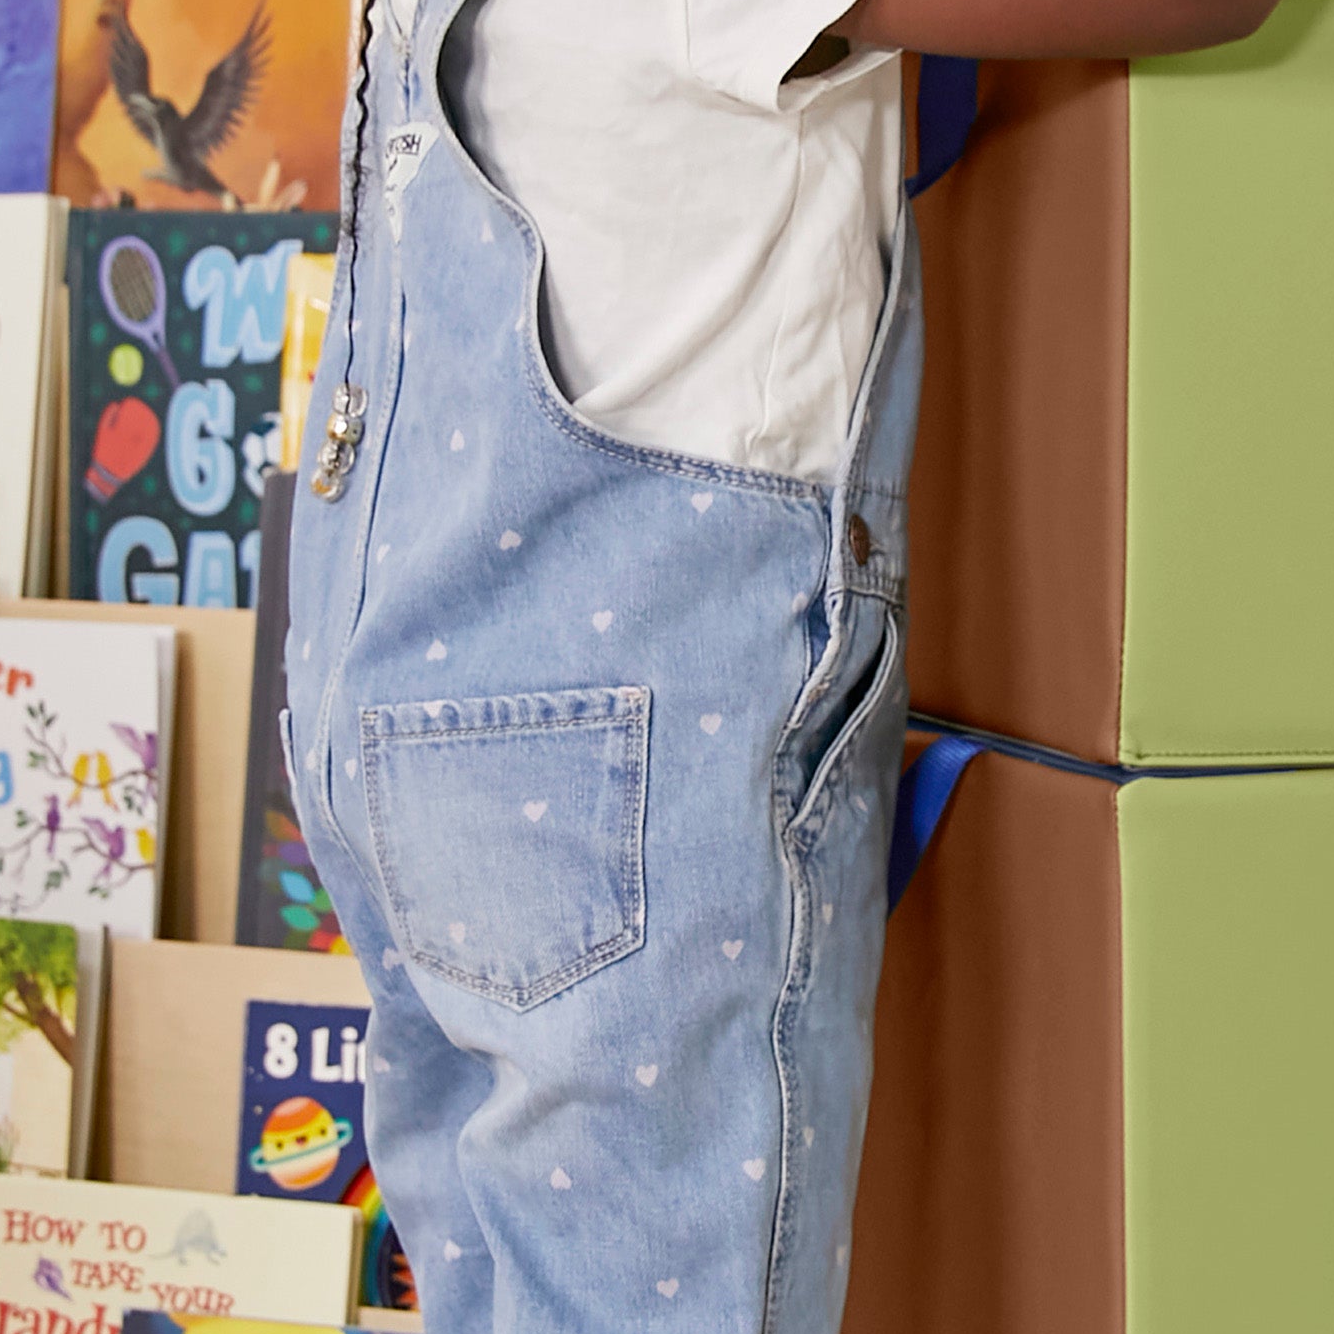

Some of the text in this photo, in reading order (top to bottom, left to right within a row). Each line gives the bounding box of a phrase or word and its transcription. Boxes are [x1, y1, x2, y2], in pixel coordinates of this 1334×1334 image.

[263, 1021, 299, 1080] 8
[99, 1219, 149, 1253] TO
[70, 1257, 146, 1294] TAKE
